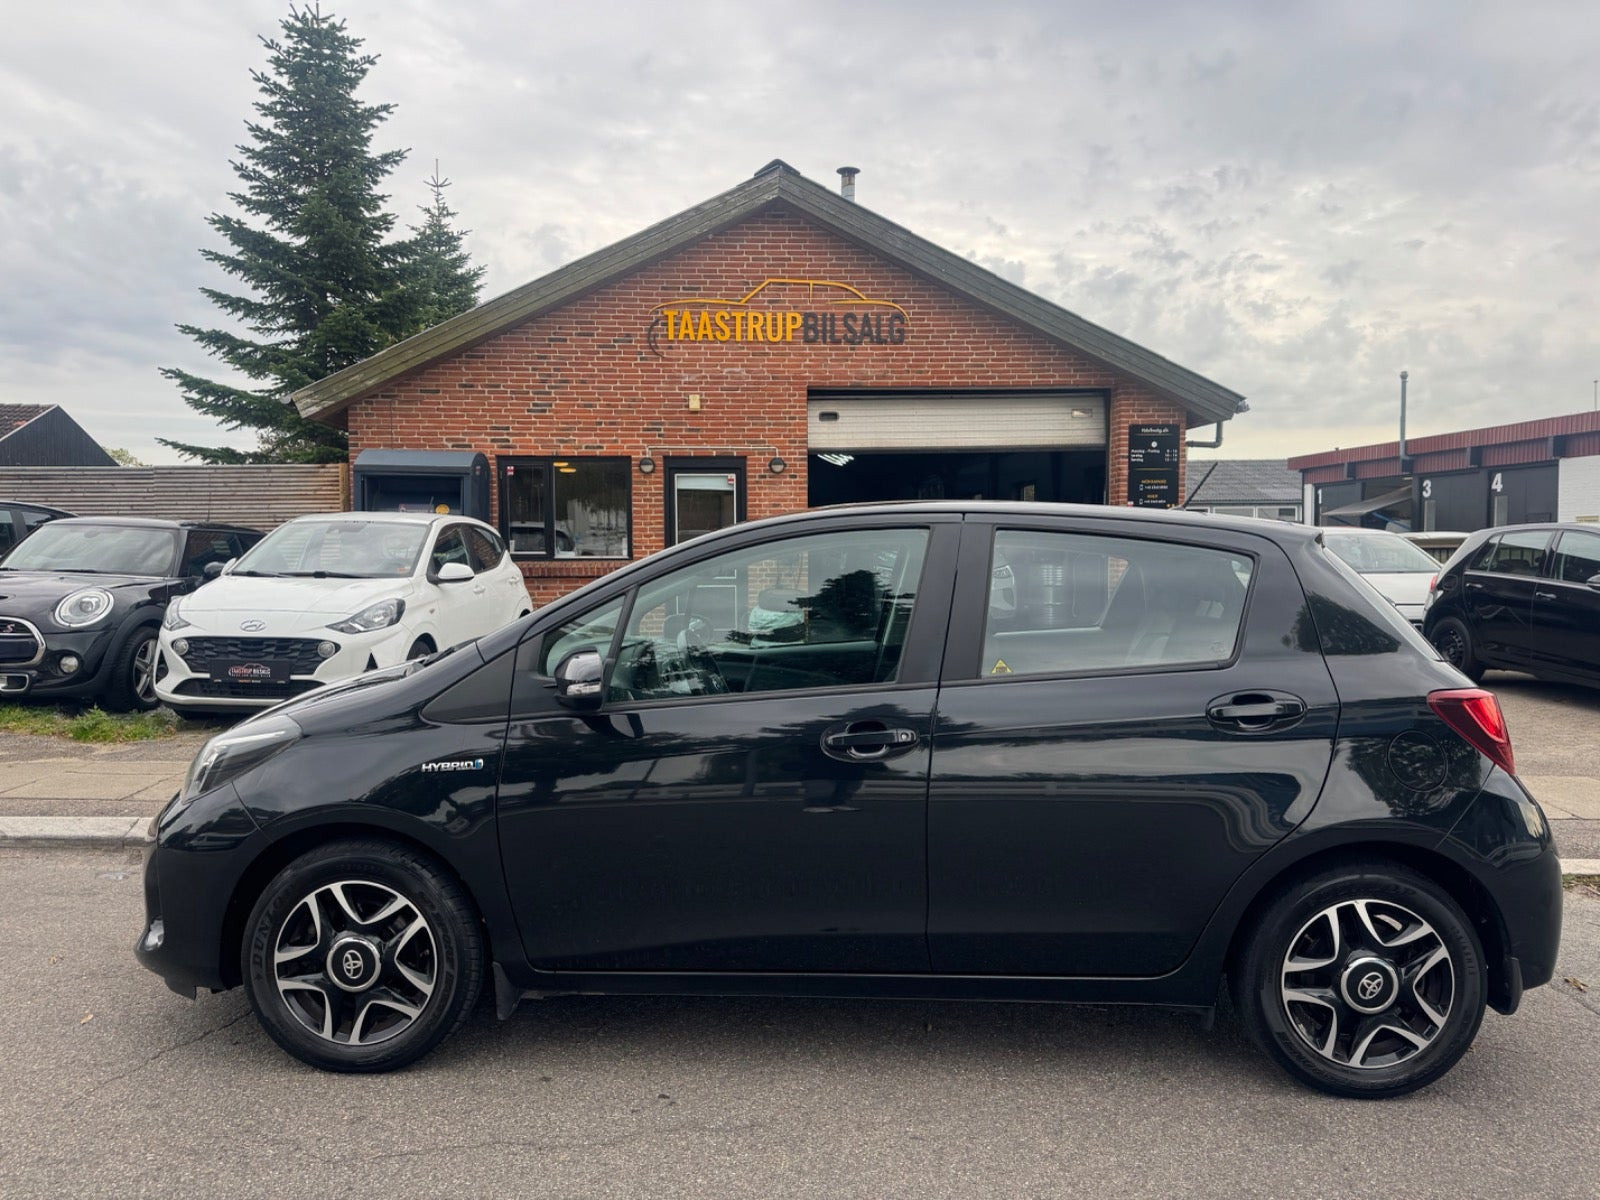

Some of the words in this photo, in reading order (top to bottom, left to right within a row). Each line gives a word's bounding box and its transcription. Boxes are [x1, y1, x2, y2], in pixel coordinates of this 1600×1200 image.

[1422, 480, 1432, 498] 3
[1491, 472, 1503, 492] 4
[421, 761, 474, 772] HYBRID
